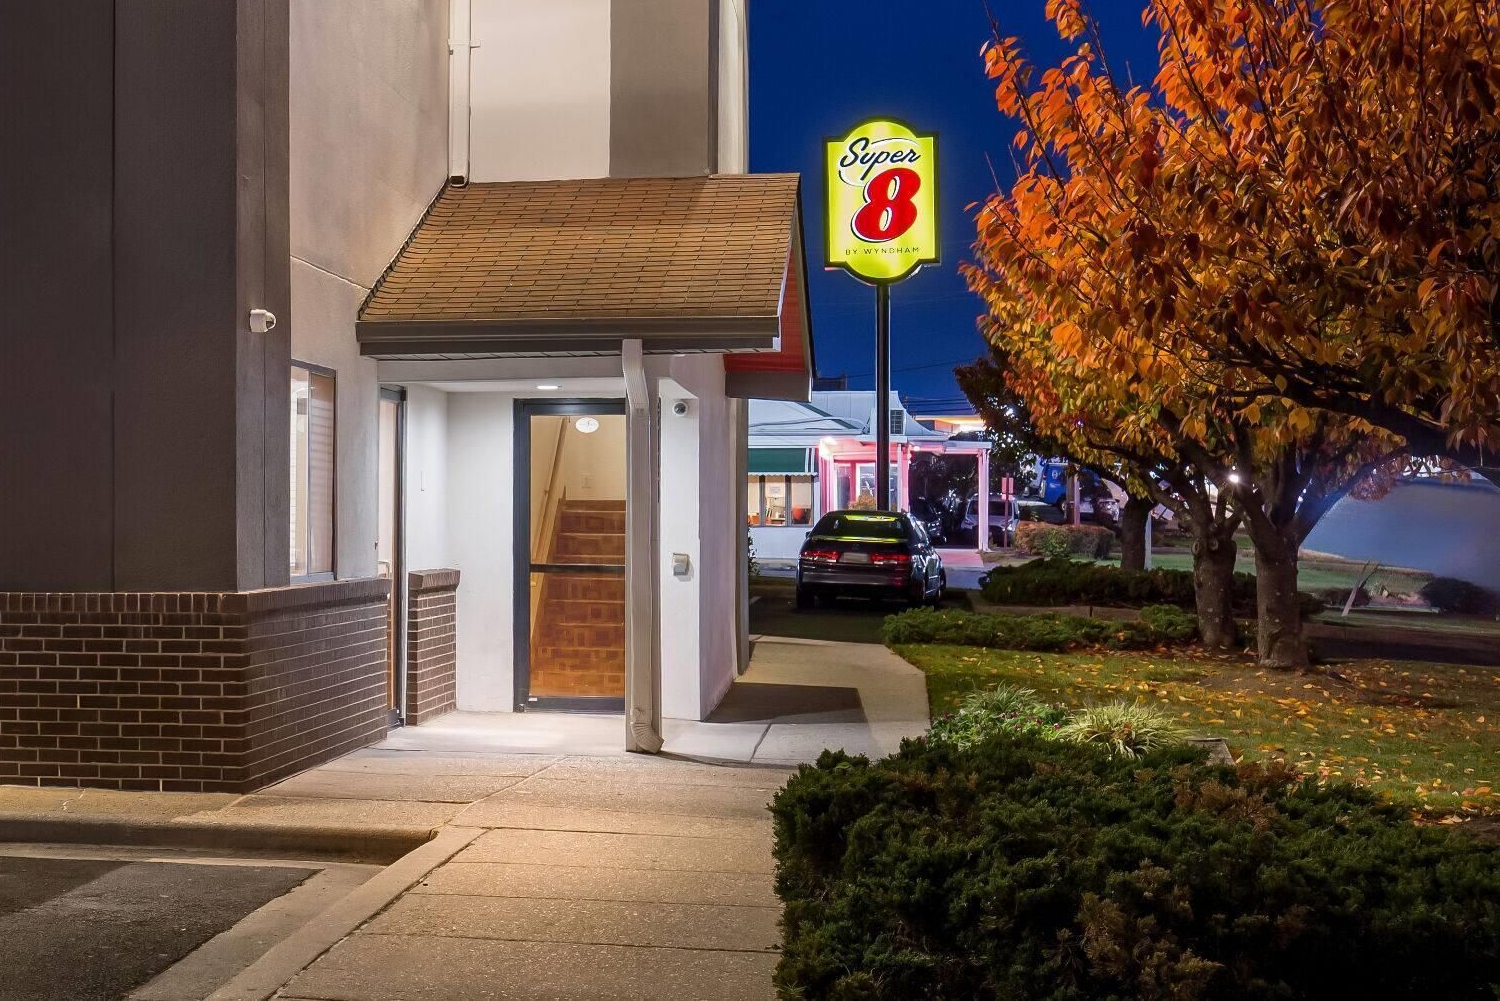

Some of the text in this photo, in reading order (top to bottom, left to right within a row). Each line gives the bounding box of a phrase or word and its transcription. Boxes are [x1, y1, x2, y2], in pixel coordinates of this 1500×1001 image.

[839, 137, 921, 181] Super
[851, 167, 921, 242] 8
[845, 246, 920, 256] BY WYNDHAM
